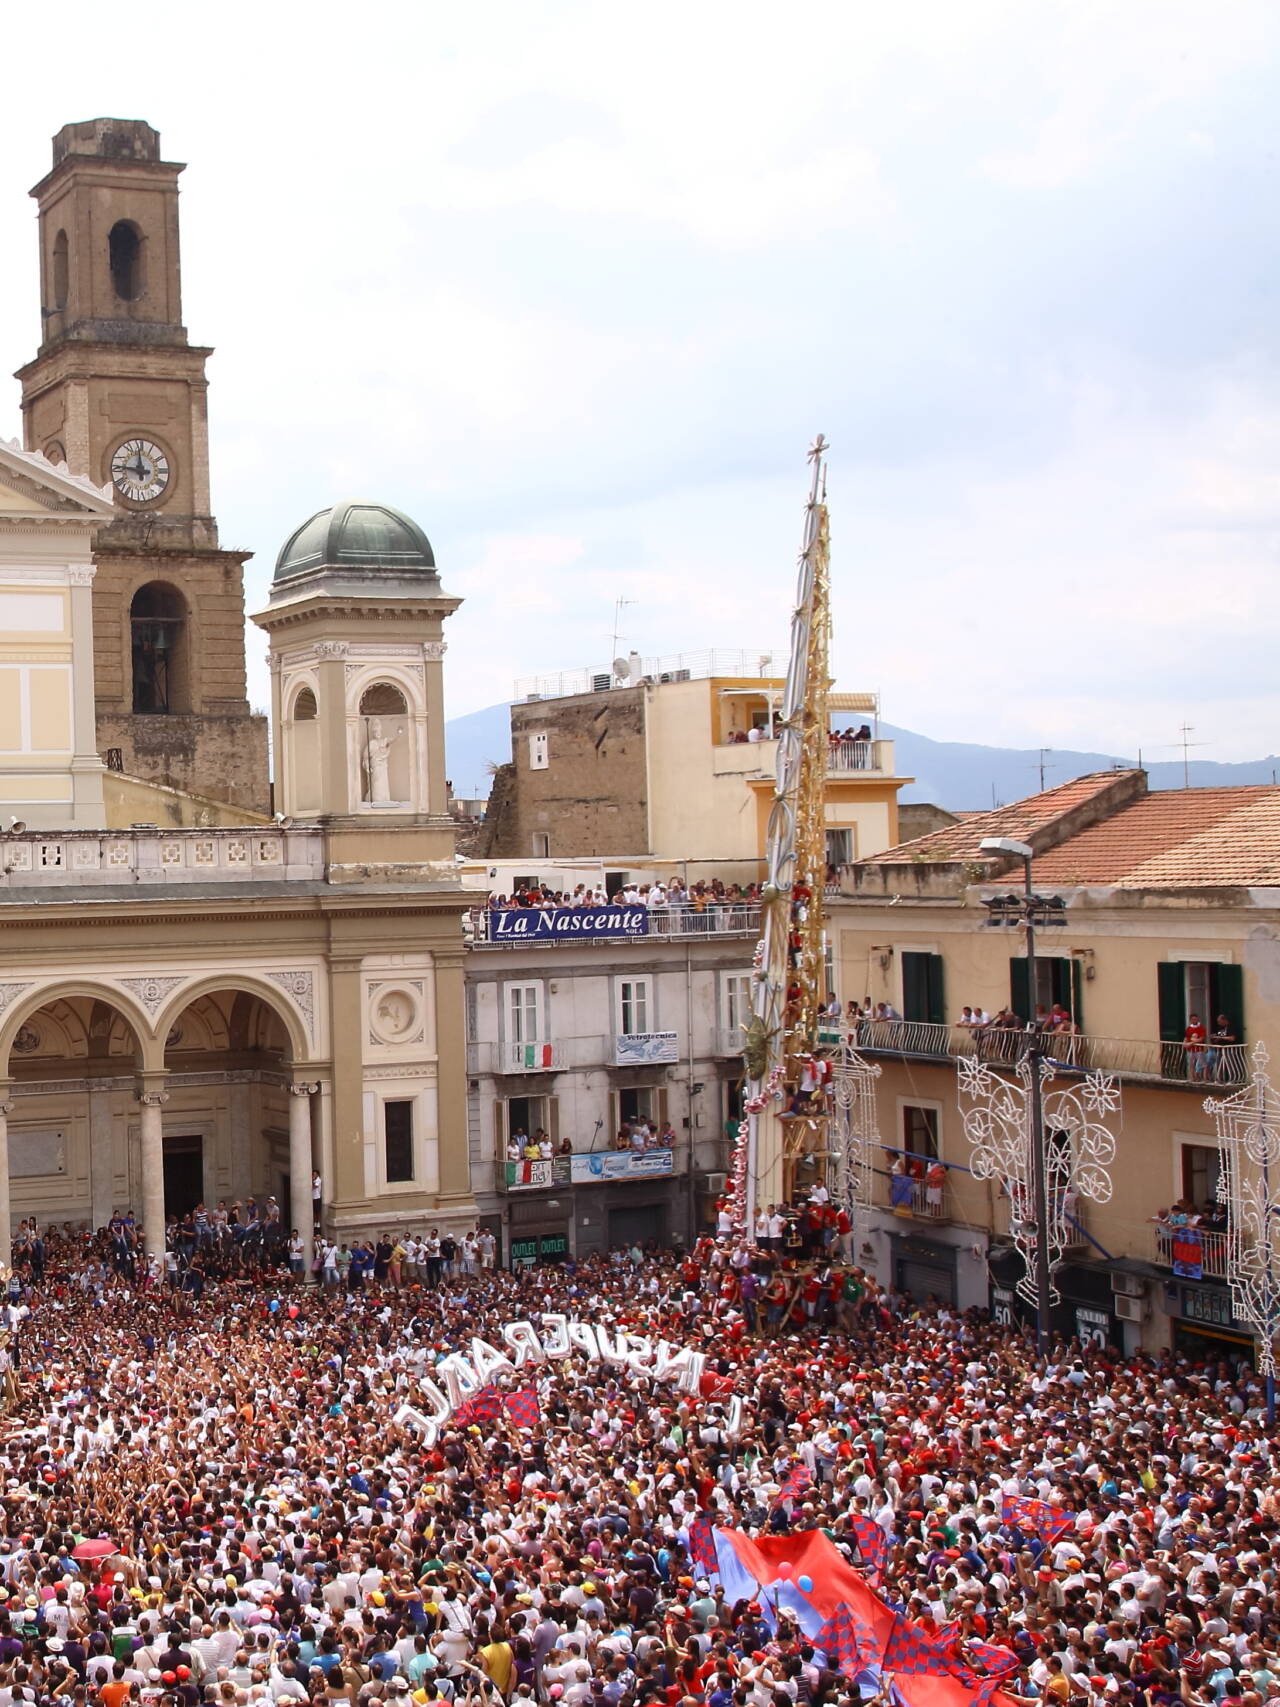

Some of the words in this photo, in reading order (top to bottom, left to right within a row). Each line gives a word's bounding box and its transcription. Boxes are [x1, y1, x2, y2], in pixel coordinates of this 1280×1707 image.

[495, 912, 528, 933] La
[535, 909, 643, 932] Nascente
[512, 1242, 537, 1257] OUTLET
[541, 1239, 566, 1253] OUTLET
[994, 1304, 1011, 1326] 50
[1075, 1307, 1109, 1325] SALDI
[1079, 1327, 1106, 1350] 50
